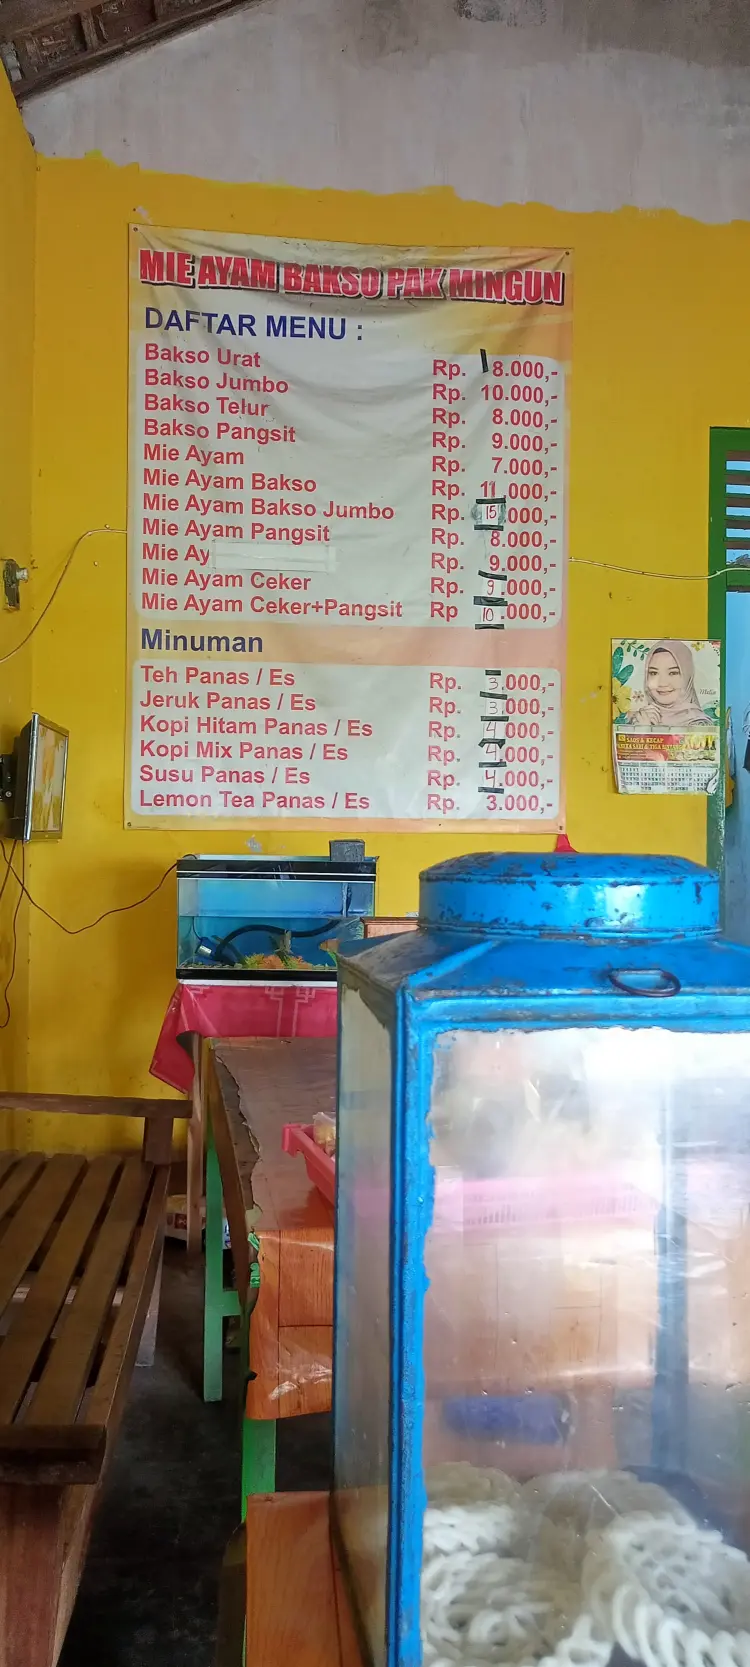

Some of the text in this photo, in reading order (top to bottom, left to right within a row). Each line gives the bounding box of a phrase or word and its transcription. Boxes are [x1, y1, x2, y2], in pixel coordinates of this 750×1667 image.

[139, 250, 565, 306] MIE AYAM BAKSO PAK MINGUN
[145, 307, 257, 336] DAFTAR
[265, 316, 347, 340] MENU
[145, 343, 210, 364] Bakso
[217, 348, 261, 368] Urat
[432, 359, 466, 379] Rp.
[144, 369, 559, 405] Bakso Jumbo Rp. 10.000,-
[144, 394, 558, 430] Bakso Telur Rp. 8.000,-
[143, 419, 558, 454] Bakso Pangsit Rp. 9.000,-
[143, 444, 558, 478] Mie Ayam Rp. 7.000,-
[143, 469, 179, 486] Mie
[185, 471, 244, 491] Ayam
[251, 473, 317, 492] Bakso
[431, 480, 465, 500] Rp.
[143, 492, 179, 511] Mie
[185, 495, 243, 518] Ayam
[250, 497, 317, 517] Bakso
[323, 500, 394, 520] Jumbo
[431, 504, 465, 524] Rp.
[142, 517, 557, 550] Mie Ayam Pangsit Rp. 8.000,-
[142, 542, 178, 562] Mie
[431, 552, 465, 573] Rp.
[489, 554, 557, 574] 9.000,-
[142, 568, 178, 586] Mie
[184, 570, 243, 592] Ayam
[250, 572, 311, 590] Ceker
[430, 577, 465, 597] Rp.
[142, 592, 178, 611] Mie
[184, 595, 243, 616] Ayam
[250, 596, 403, 621] Ceker+Pangsit
[430, 601, 460, 622] Rp
[142, 628, 263, 652] Minuman
[141, 665, 178, 684] Teh
[186, 667, 250, 686] Panas
[256, 667, 263, 685] /
[269, 668, 296, 686] Es
[430, 672, 462, 693] Rp.
[140, 690, 199, 710] Jeruk
[207, 692, 271, 710] Panas
[278, 693, 283, 711] /
[290, 693, 317, 711] Es
[429, 697, 461, 717] Rp.
[140, 716, 555, 742] Kopi Hitam Panas / Es Rp. 4000,-
[140, 740, 190, 760] Kopi
[196, 741, 233, 760] Mix
[240, 742, 304, 761] Panas
[310, 743, 316, 761] /
[323, 744, 348, 761] Es
[428, 745, 461, 766] Rp.
[140, 765, 194, 784] Susu
[202, 766, 265, 784] Panas
[272, 767, 278, 785] /
[285, 767, 310, 785] Es
[428, 770, 460, 790] Rp.
[140, 790, 553, 814] Lemon Tea Panas / Es Rp. 3.000,-
